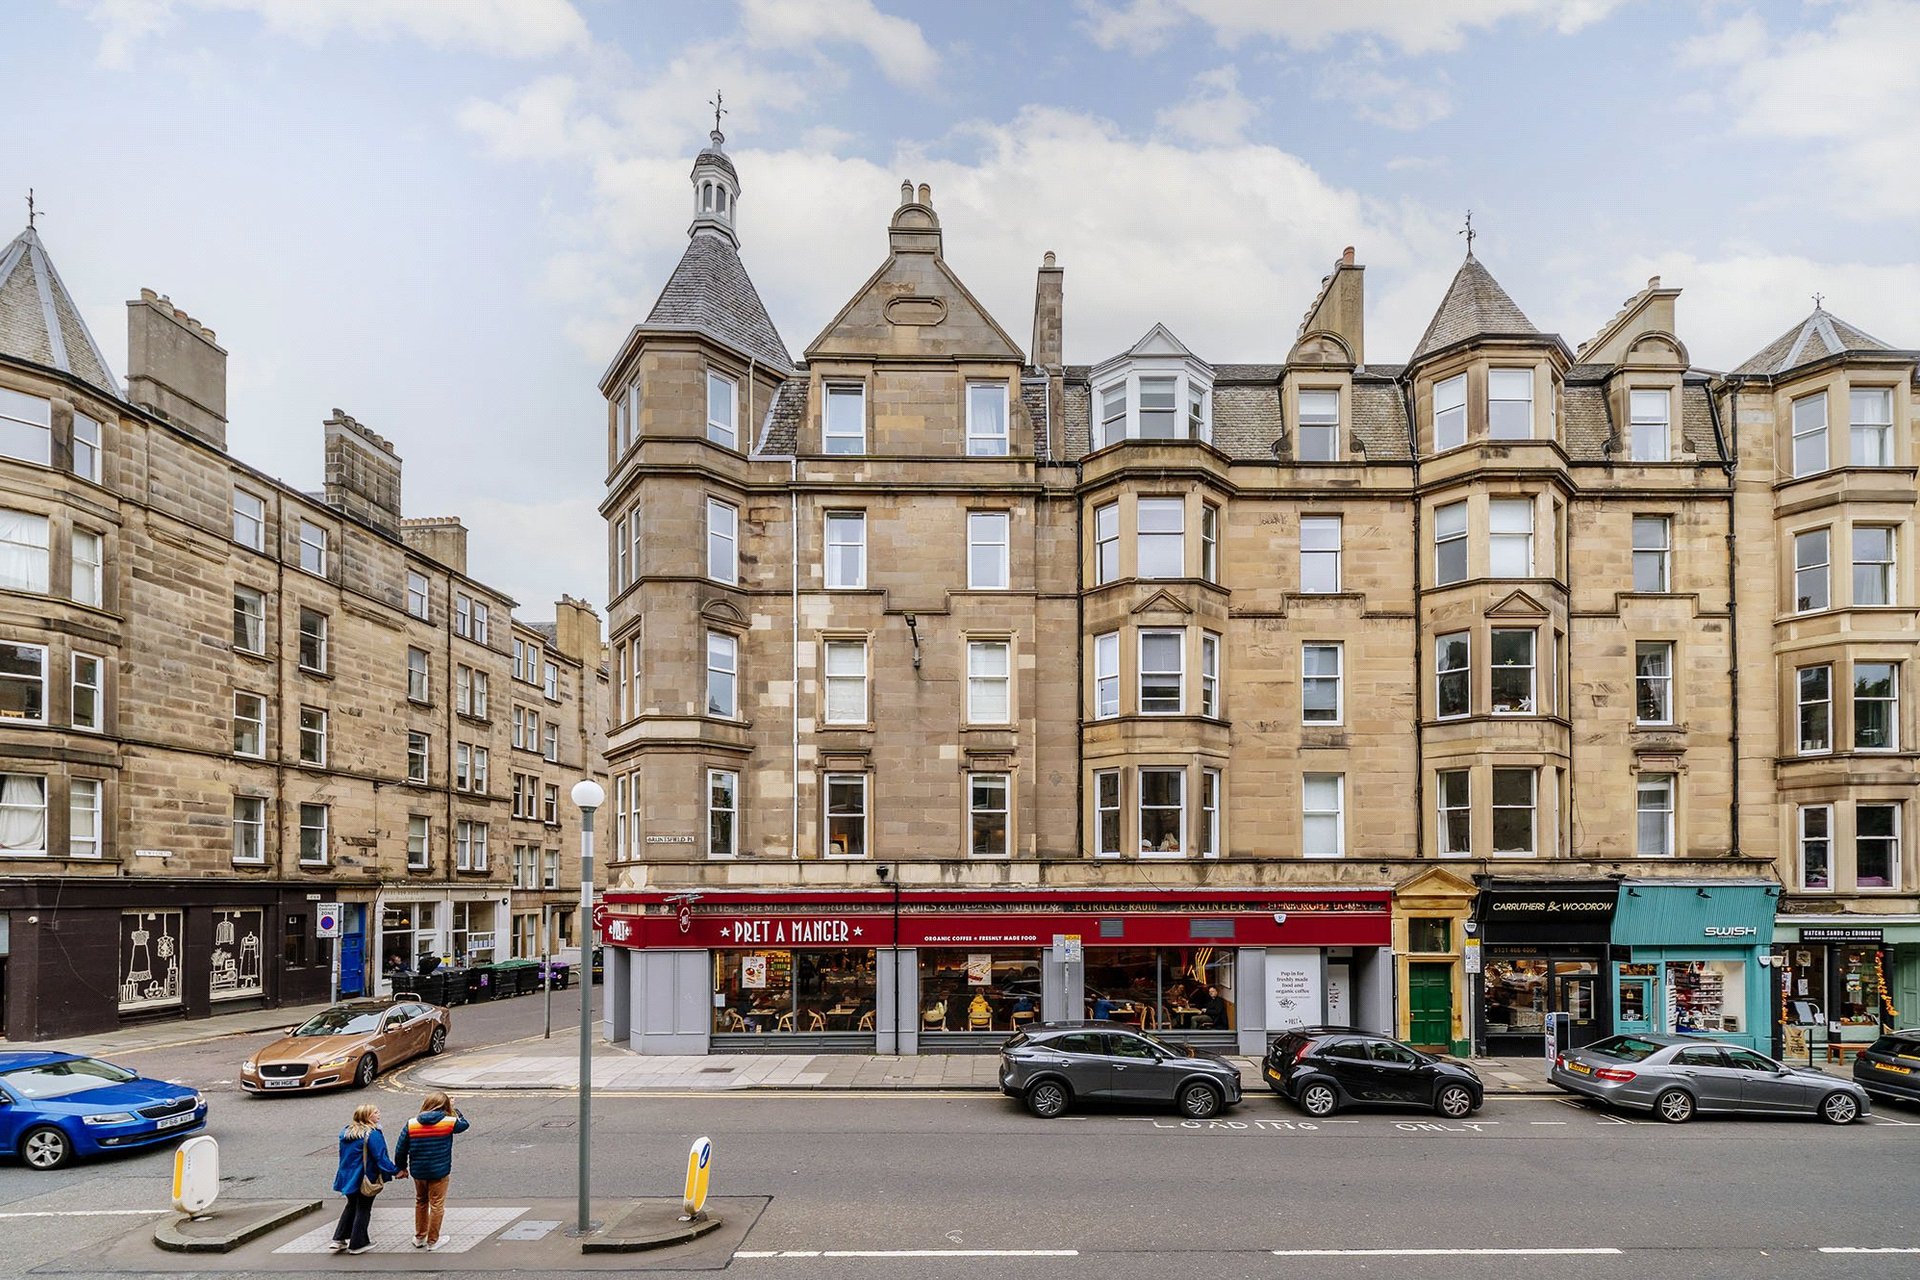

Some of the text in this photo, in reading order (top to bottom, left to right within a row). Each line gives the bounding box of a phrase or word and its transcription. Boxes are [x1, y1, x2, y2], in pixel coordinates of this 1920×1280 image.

[1492, 901, 1613, 912] CARRUTHERS & WOODROW
[734, 920, 849, 943] PRET A MANGER
[1704, 926, 1757, 936] SWISH
[1152, 1120, 1485, 1132] LOADING ONLY
